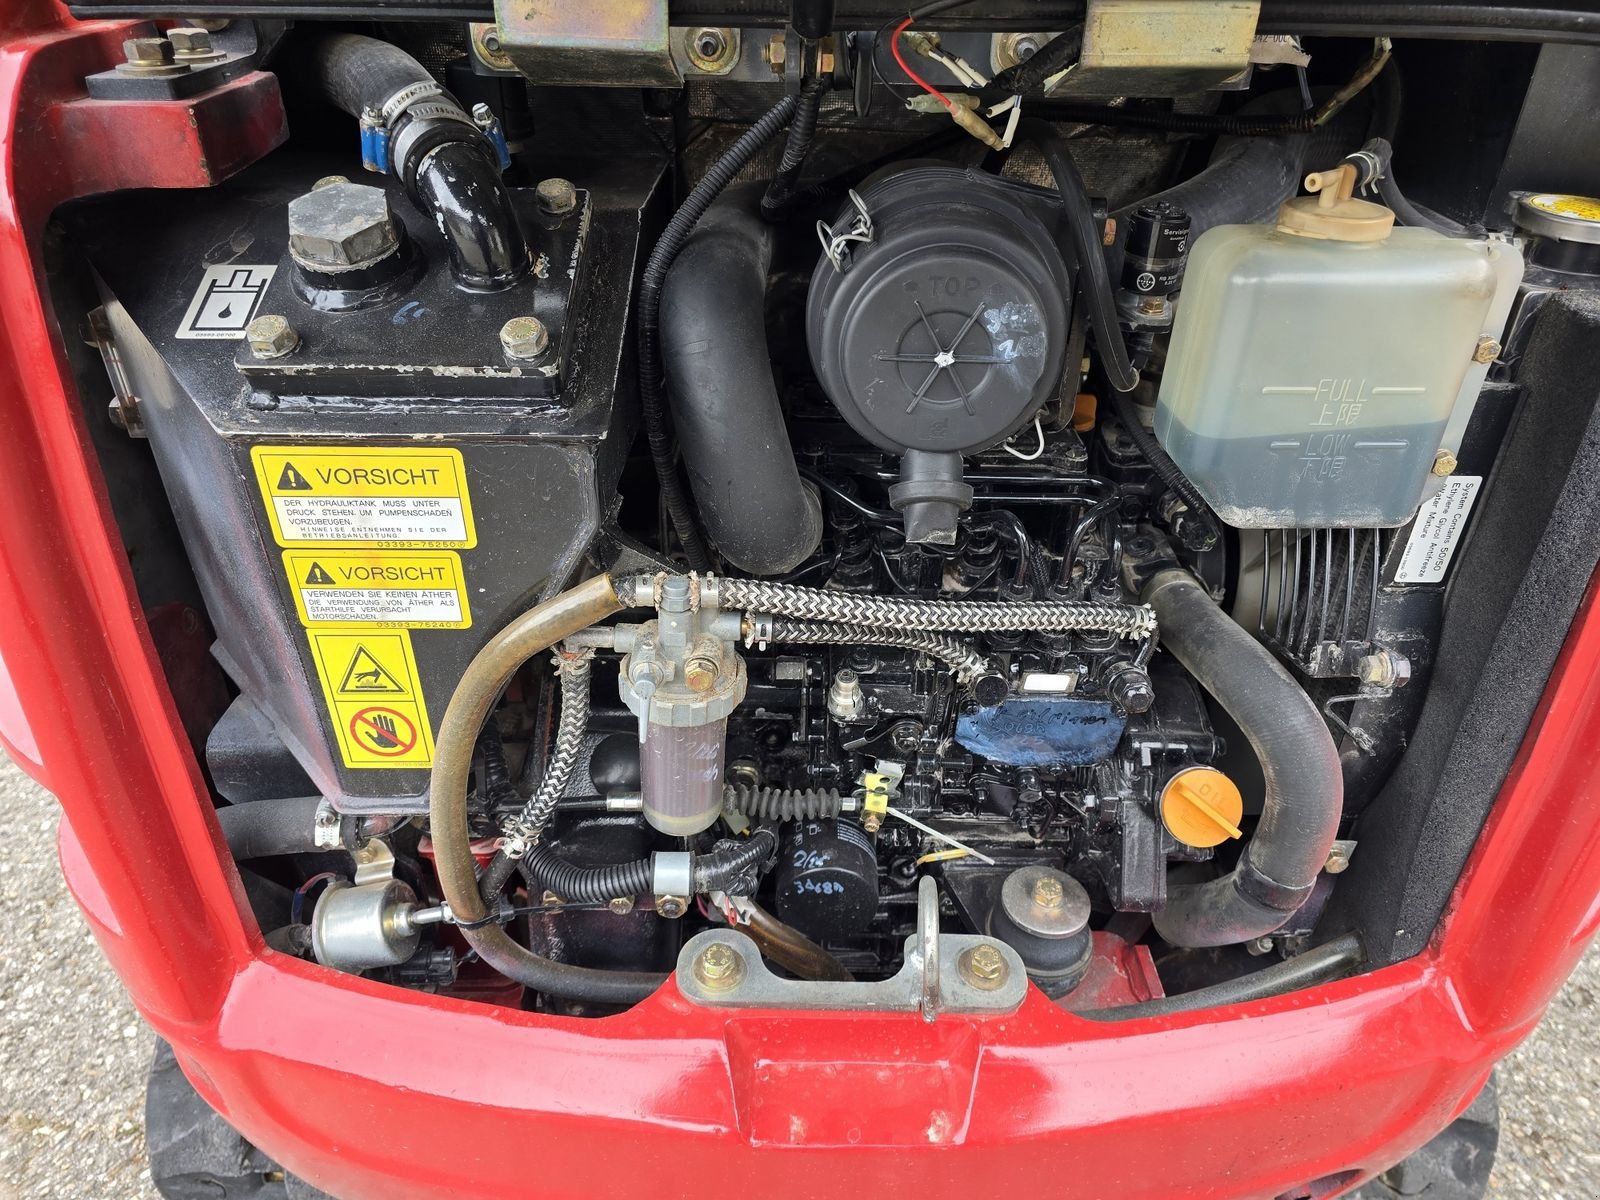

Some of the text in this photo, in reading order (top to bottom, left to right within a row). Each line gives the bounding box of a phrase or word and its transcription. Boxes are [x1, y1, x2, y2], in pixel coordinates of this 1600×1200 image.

[928, 275, 982, 297] TOP
[1314, 378, 1368, 402] FULL
[1309, 403, 1362, 426] 上限
[1304, 434, 1351, 456] LOW
[315, 467, 440, 486] VORSICHT
[284, 499, 441, 508] DER HYDRAULIKTANK MUSS UNTER
[286, 508, 315, 517] DRUCK
[359, 509, 373, 517] UM
[288, 518, 353, 526] VORZUBEUGEN.
[1418, 482, 1461, 577] Ethylene Glycol Antifreeze
[1420, 511, 1437, 539] Mixture
[1433, 482, 1474, 571] System Contains 50/50
[338, 566, 446, 581] VORSICHT
[307, 590, 364, 598] VERWENDEN
[367, 591, 382, 599] SIE
[385, 591, 418, 599] KEINEN
[386, 599, 403, 607] VON
[440, 599, 455, 607] ALS
